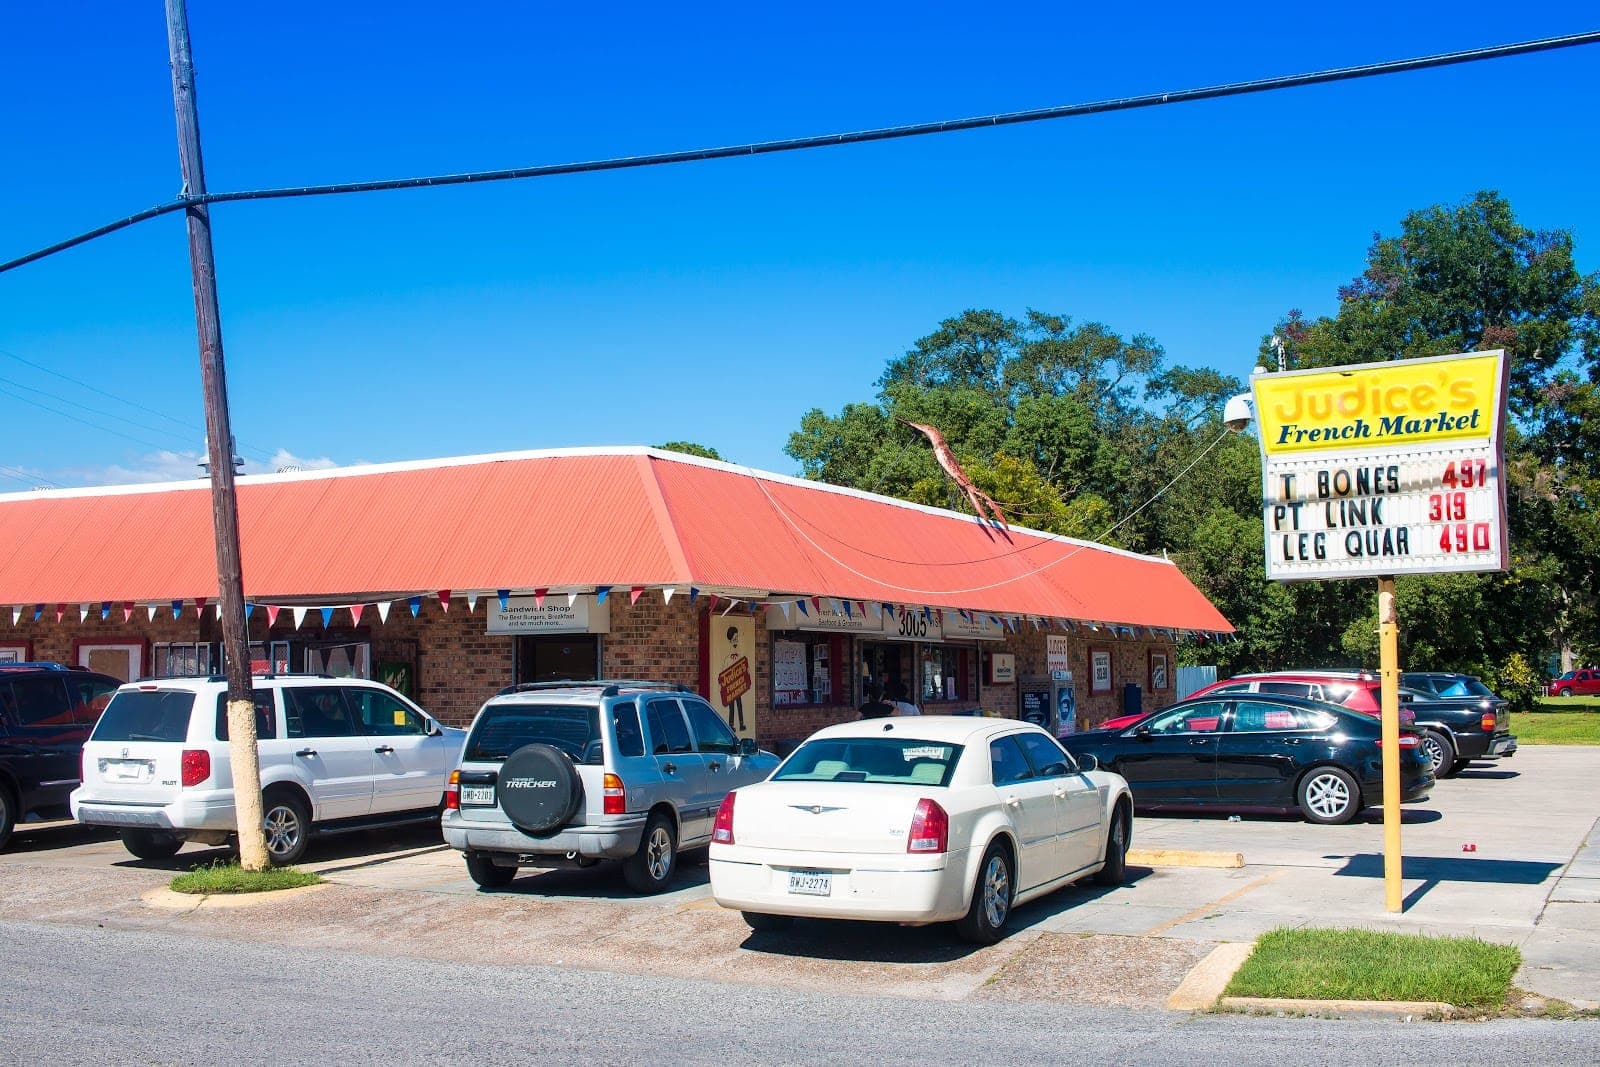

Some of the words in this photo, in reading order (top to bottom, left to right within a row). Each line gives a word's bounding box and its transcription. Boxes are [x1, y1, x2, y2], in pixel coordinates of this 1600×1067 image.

[1271, 371, 1477, 422] Judice's
[1276, 419, 1372, 445] French
[1377, 408, 1481, 438] Market
[1280, 472, 1296, 501] T
[1317, 465, 1400, 499] BONES
[1441, 458, 1487, 490] 497
[1273, 501, 1304, 532] PT
[1325, 497, 1384, 529] LINK
[1428, 491, 1467, 522] 319
[1282, 532, 1326, 562] LEG
[1344, 525, 1409, 559] QUAR
[1439, 522, 1491, 554] 490
[502, 605, 545, 613] Sandwich
[547, 605, 571, 613] Shop
[898, 610, 928, 637] 3005
[506, 780, 557, 789] TRACKER
